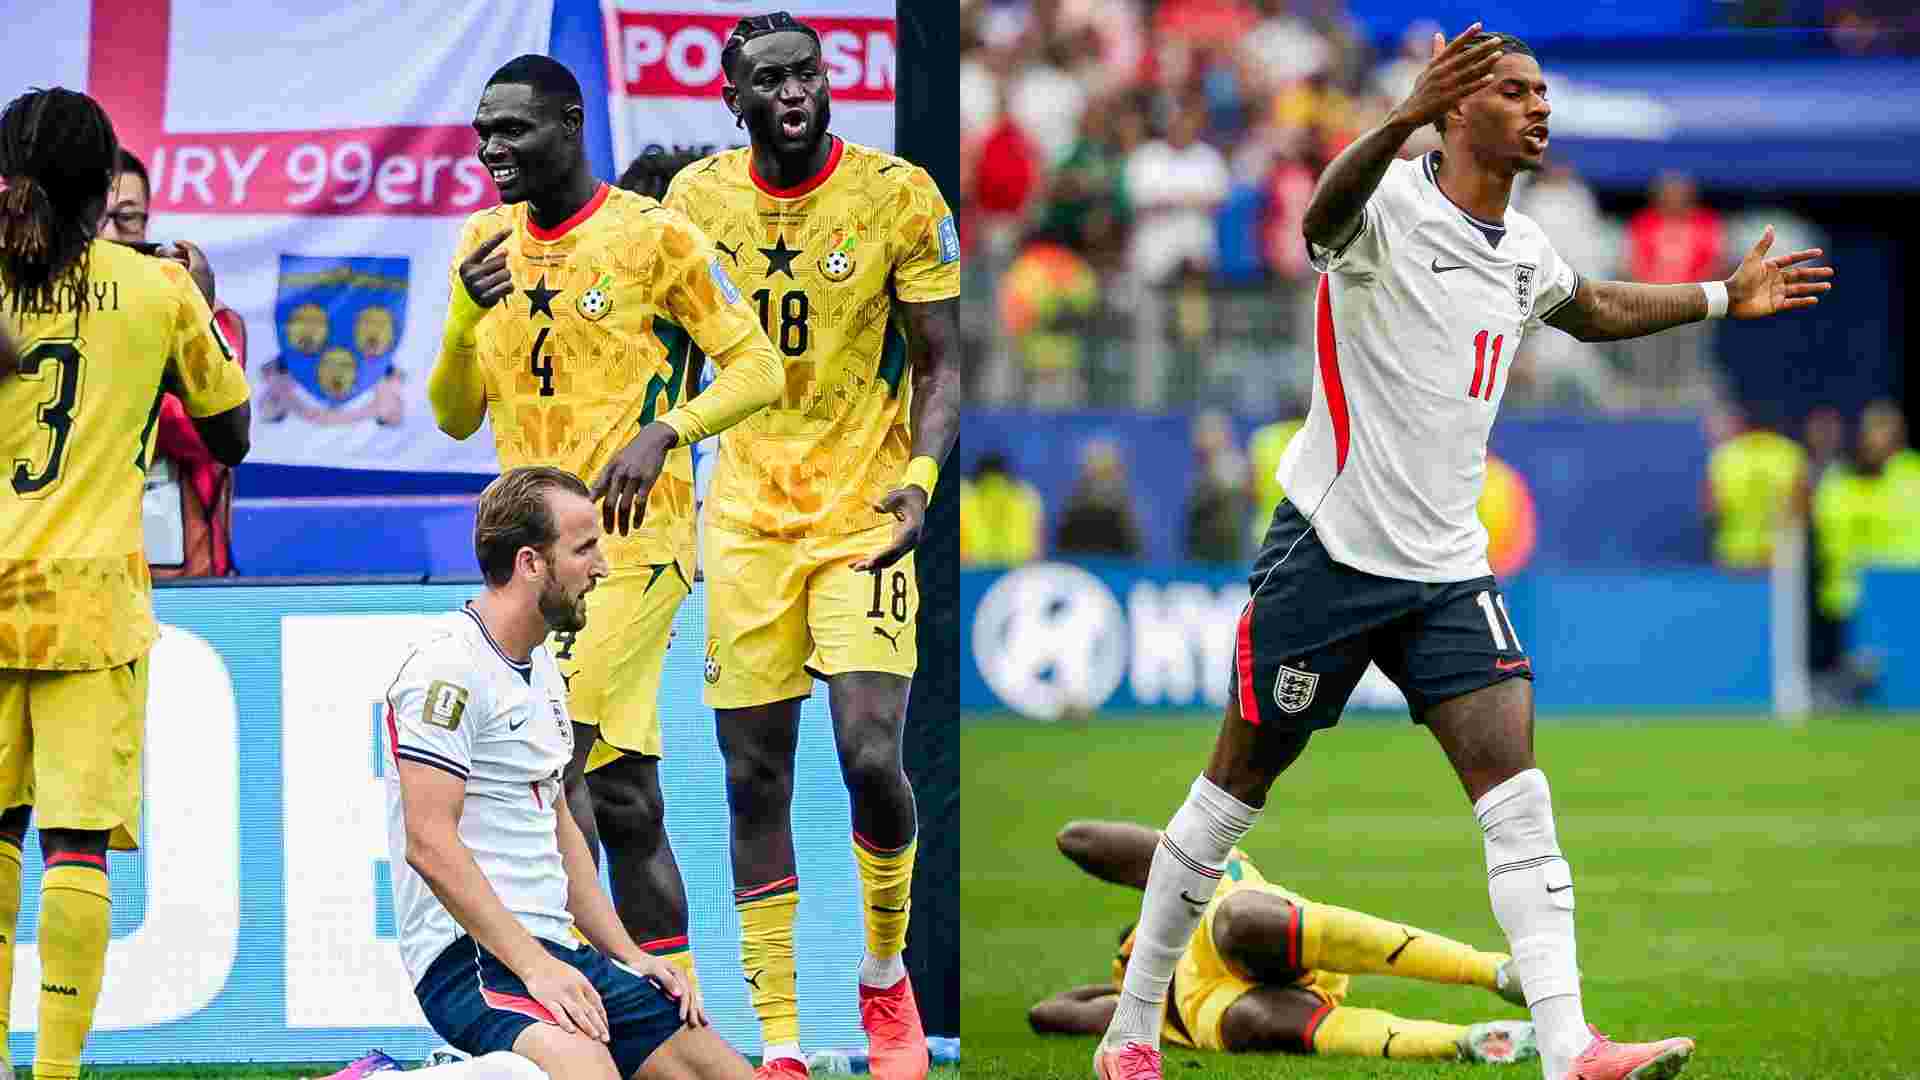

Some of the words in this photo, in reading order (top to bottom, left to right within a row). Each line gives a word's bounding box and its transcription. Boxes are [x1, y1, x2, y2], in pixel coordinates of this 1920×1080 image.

[285, 142, 486, 207] 99ers
[752, 288, 809, 357] 18
[531, 327, 554, 396] 4
[1468, 330, 1504, 401] 11
[12, 337, 87, 500] 3
[866, 567, 906, 623] 18
